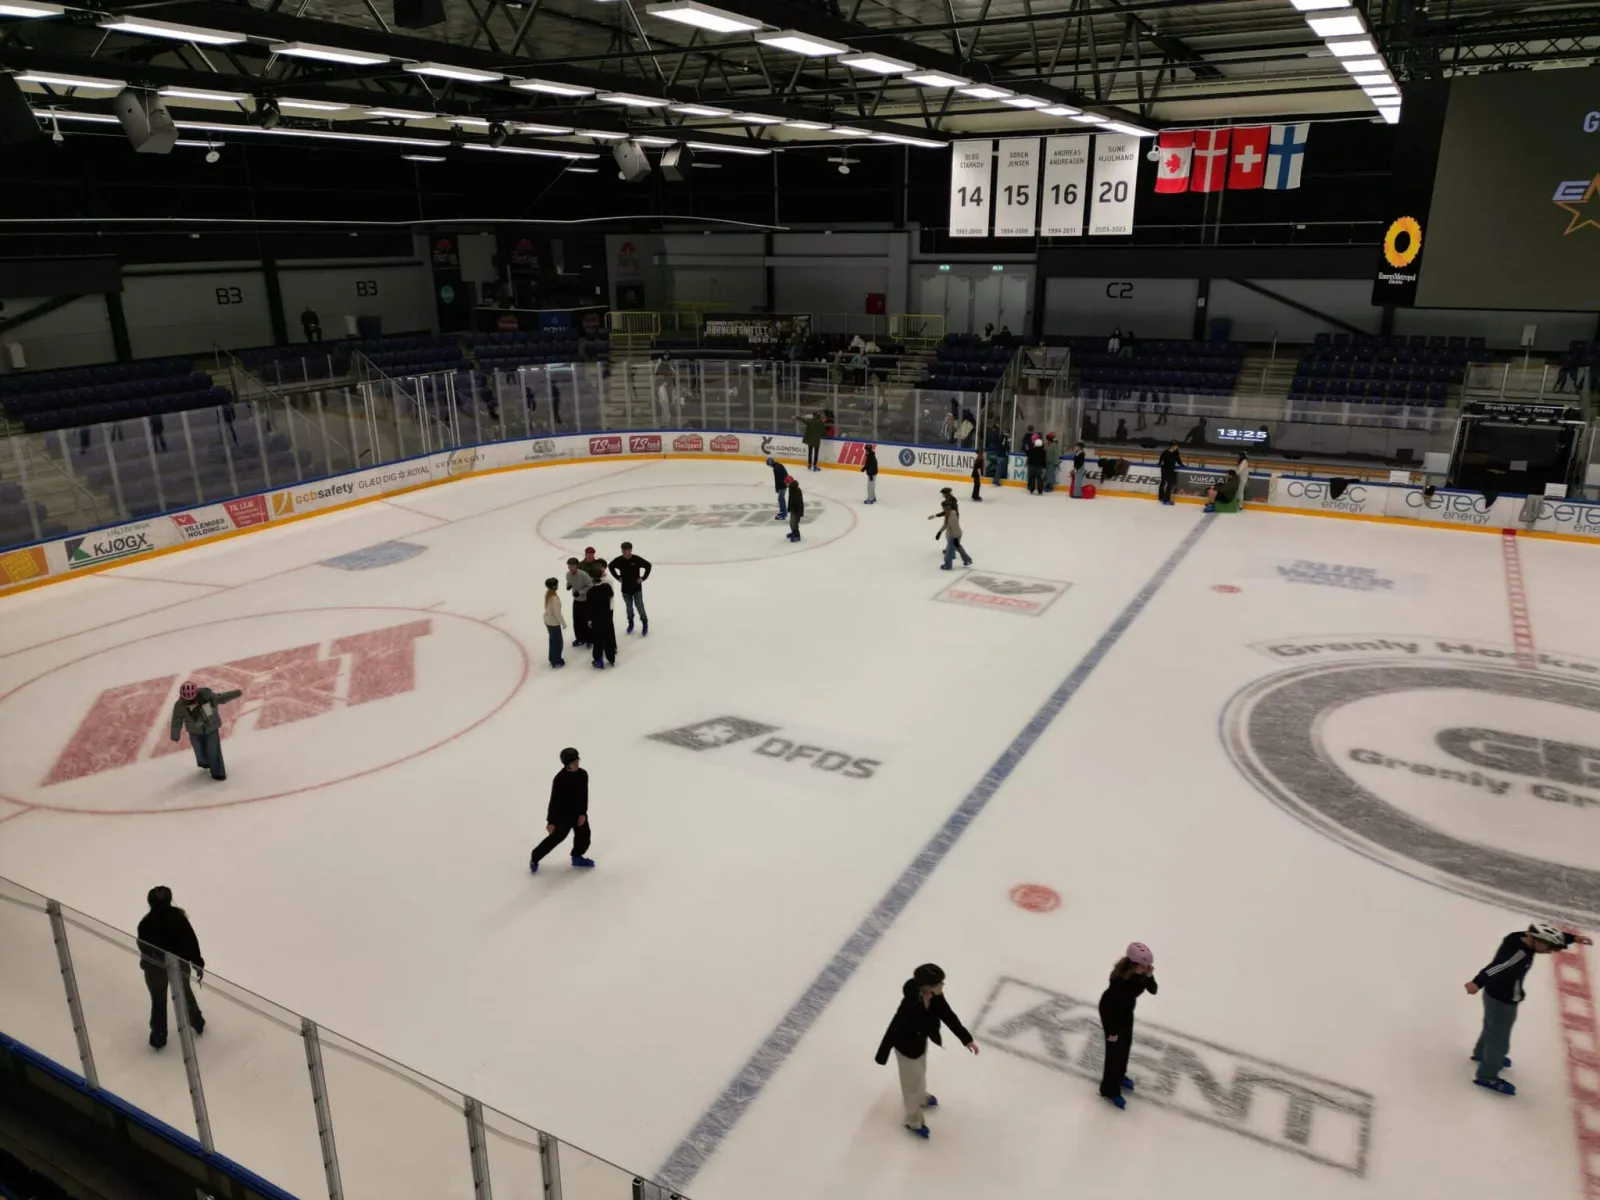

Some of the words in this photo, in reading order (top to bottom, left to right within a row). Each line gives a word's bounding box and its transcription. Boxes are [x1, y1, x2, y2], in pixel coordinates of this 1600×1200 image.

[1009, 151, 1029, 159] SØREN
[1053, 149, 1081, 157] ANDREAS
[1108, 145, 1126, 153] SUNE
[960, 161, 984, 169] STARKOV
[1007, 159, 1029, 168] JENSEN
[1049, 157, 1085, 166] ANDREASEN
[1098, 154, 1134, 163] HJULMAND
[957, 186, 983, 207] 14
[1003, 184, 1029, 206] 15
[1050, 183, 1078, 205] 16
[1099, 181, 1128, 204] 20
[215, 287, 243, 305] B3
[356, 280, 378, 297] B3
[1106, 282, 1134, 299] C2
[1484, 404, 1505, 412] Granly
[1217, 428, 1268, 439] 13:25
[918, 452, 975, 469] VESTJYLLAND
[358, 476, 382, 490] GLÆD
[383, 472, 397, 484] DIG
[407, 465, 429, 478] ROYAL
[1321, 499, 1365, 513] energy
[184, 518, 225, 533] VILLEMOES
[1443, 510, 1490, 525] energy
[187, 526, 220, 538] HOLDING
[93, 531, 148, 557] KJØGX
[1268, 638, 1419, 658] Granly
[753, 736, 883, 779] DFDS
[1349, 748, 1511, 796] Granly
